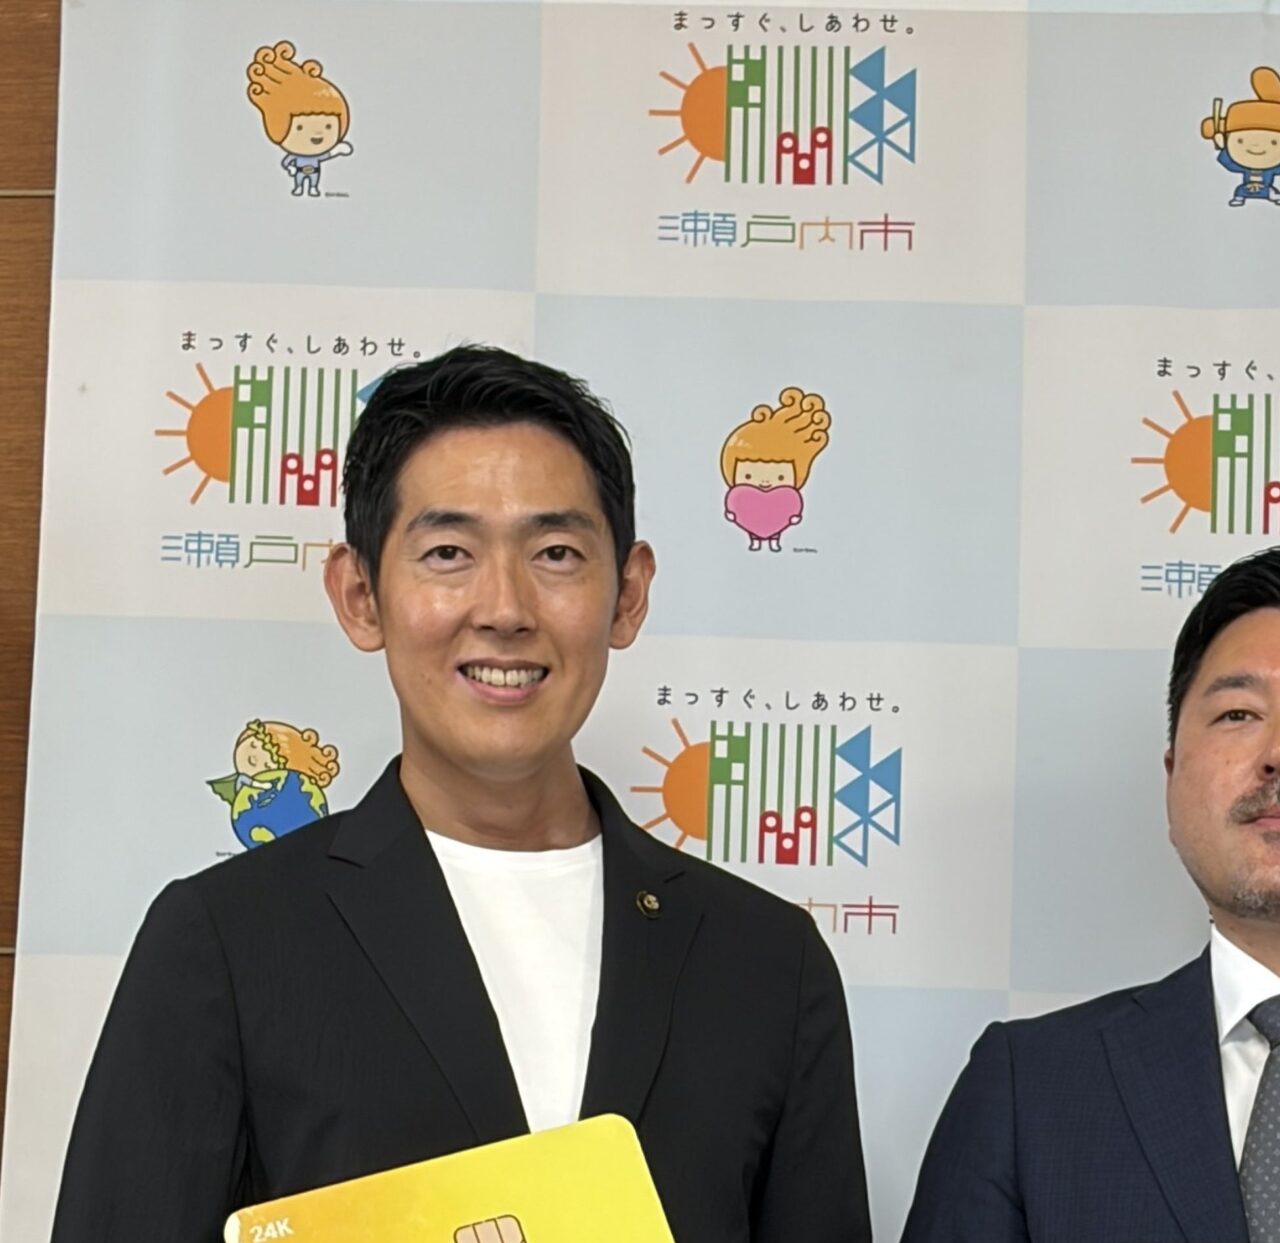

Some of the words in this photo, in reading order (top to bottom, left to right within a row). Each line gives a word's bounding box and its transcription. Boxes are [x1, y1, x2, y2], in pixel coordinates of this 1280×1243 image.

[674, 10, 914, 35] まっすぐ、しあわせ。
[658, 209, 915, 251] 瀬戸内市
[181, 330, 421, 359] まっすぐ、しあわせ。
[656, 685, 900, 714] まっすぐ、しあわせ。
[250, 1217, 293, 1243] 24K
